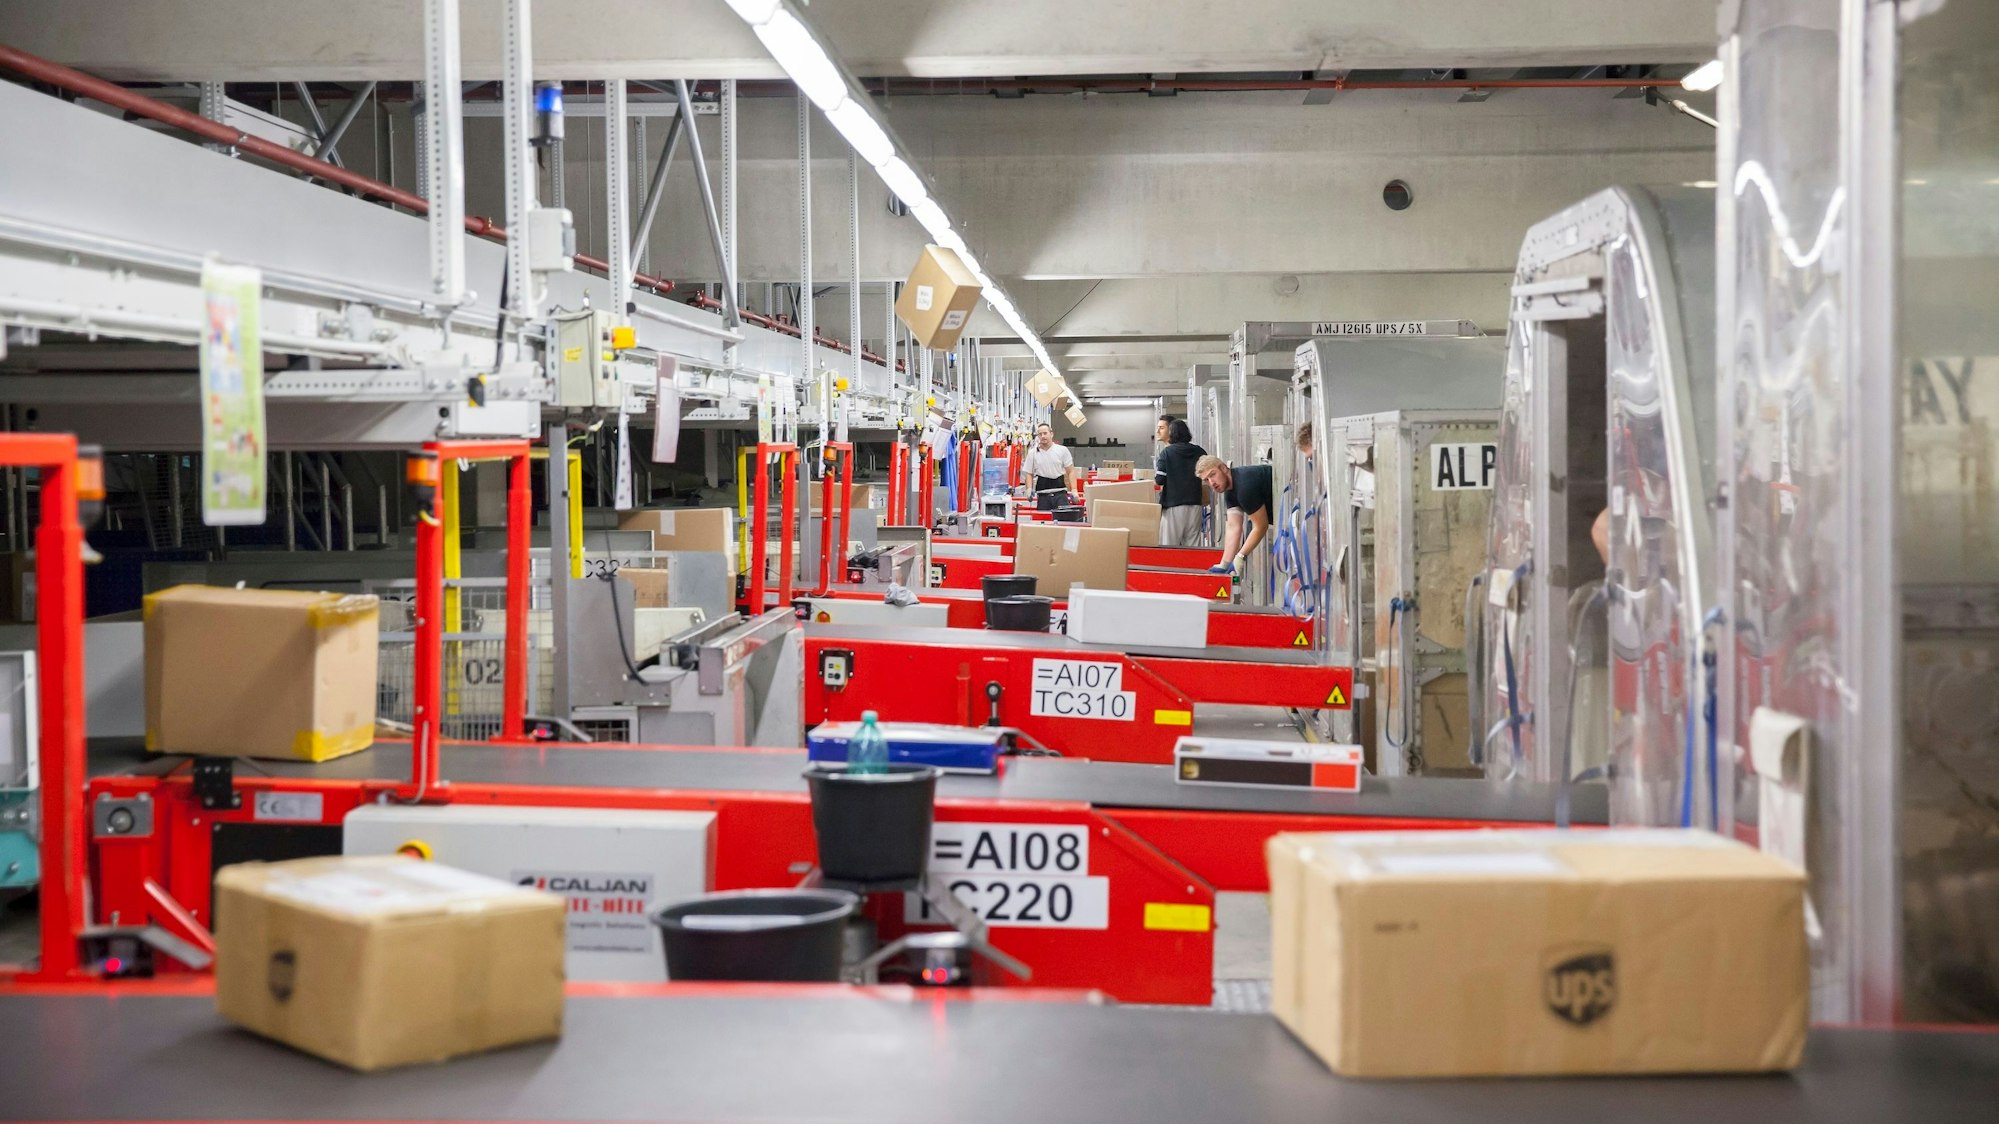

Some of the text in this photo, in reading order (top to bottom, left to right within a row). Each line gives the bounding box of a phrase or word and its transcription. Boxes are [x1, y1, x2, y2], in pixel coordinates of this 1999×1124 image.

[1316, 323, 1339, 334] AMJ
[1343, 323, 1372, 334] 12615
[1037, 664, 1118, 689] =AI07
[1035, 690, 1127, 718] TC310
[934, 831, 1080, 872] =AI08
[549, 877, 647, 893] CALJAN
